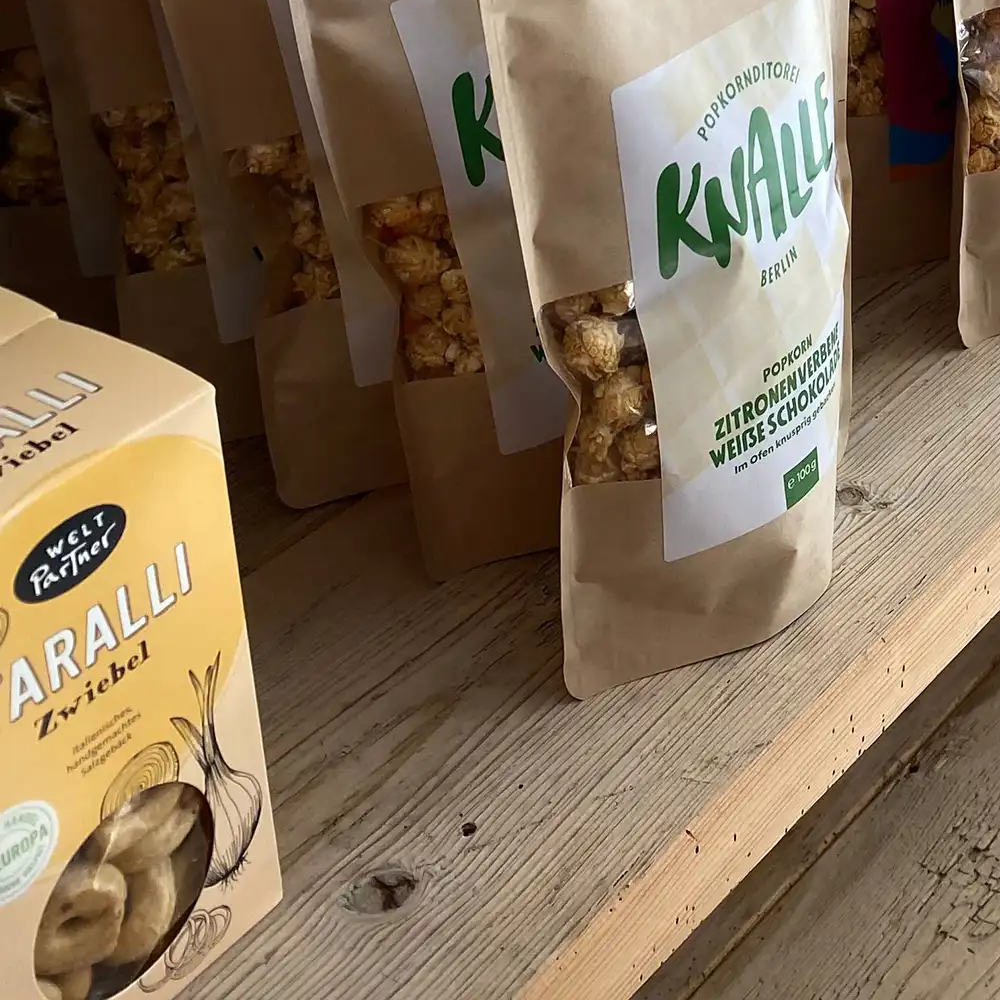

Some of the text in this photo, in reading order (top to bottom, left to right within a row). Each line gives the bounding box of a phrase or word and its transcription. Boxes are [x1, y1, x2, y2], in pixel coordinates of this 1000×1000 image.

[696, 61, 801, 142] POPKORNDITOREI
[656, 71, 833, 281] KNALLE
[760, 246, 798, 288] BERLIN
[714, 321, 840, 441] ZITRONENVERBENE
[763, 333, 813, 383] POPKORN
[768, 340, 841, 436] SCHOKOLADE
[749, 446, 774, 465] Ofen
[775, 414, 813, 449] knusprig
[46, 511, 105, 559] WELT
[33, 640, 151, 741] Zwiebel
[0, 823, 48, 871] UROPA
